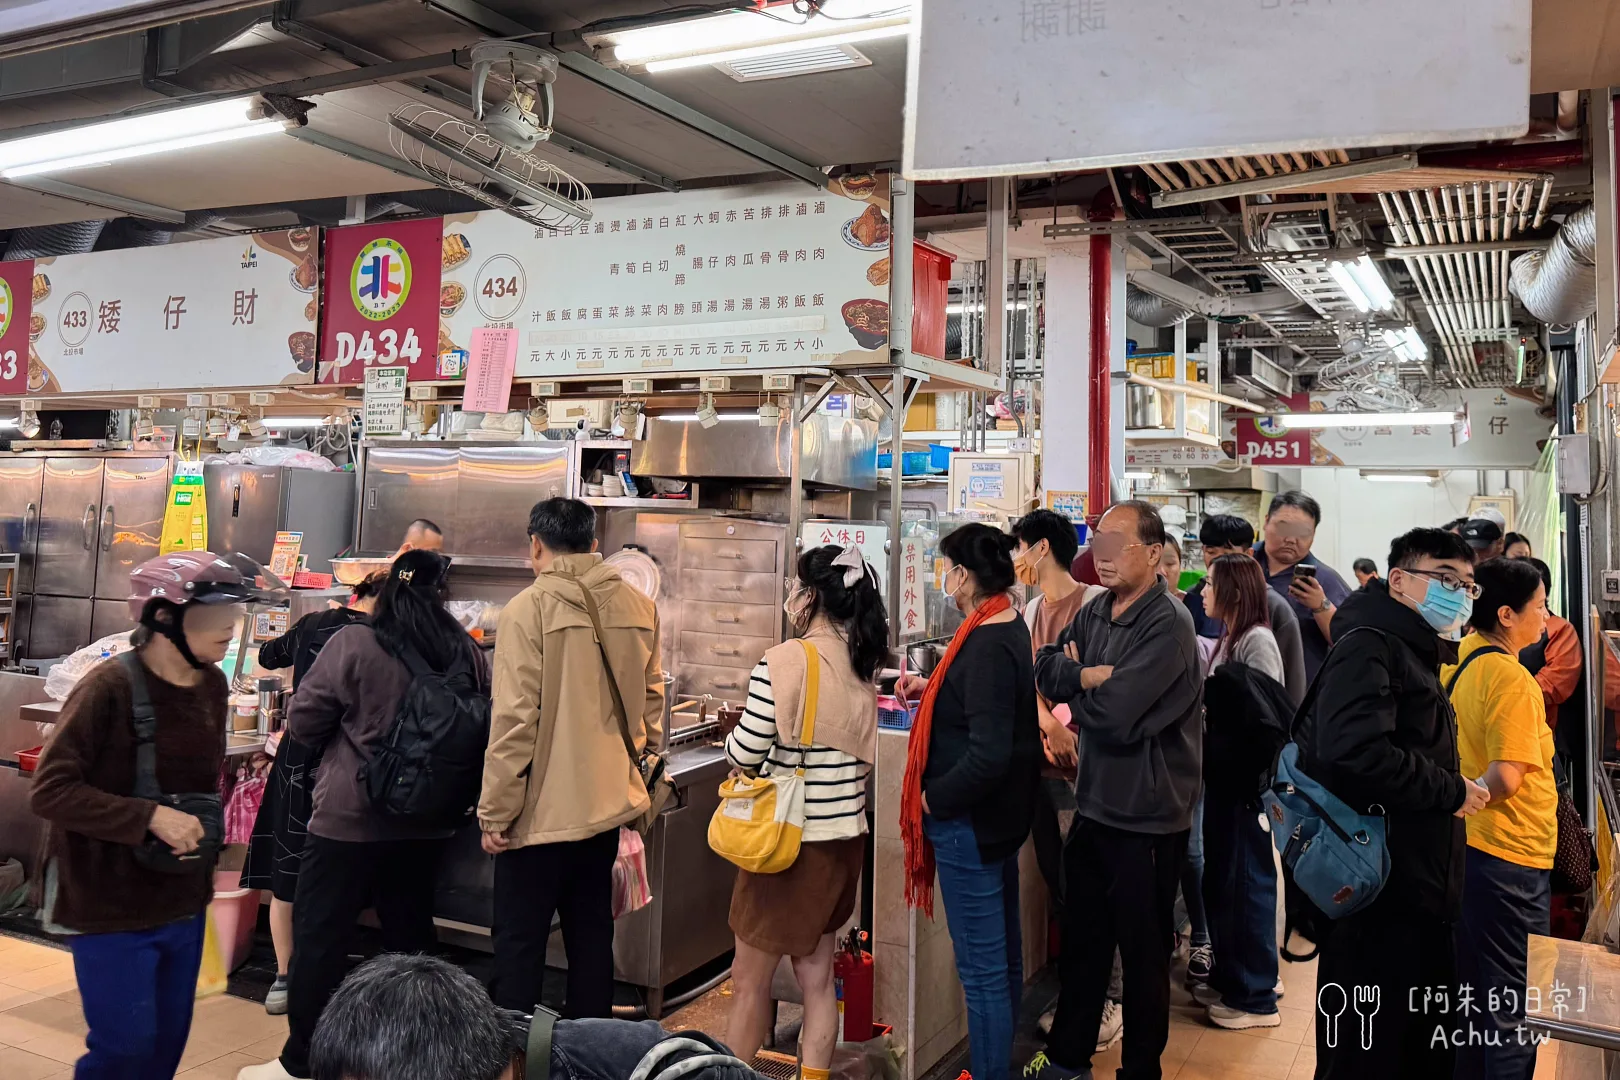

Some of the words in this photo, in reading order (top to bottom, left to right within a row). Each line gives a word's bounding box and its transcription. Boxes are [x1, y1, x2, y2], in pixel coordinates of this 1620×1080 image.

[482, 276, 518, 298] 434
[63, 310, 87, 328] 433
[336, 327, 422, 368] D434
[1246, 441, 1300, 459] D451
[820, 528, 865, 545] 公休日
[903, 543, 918, 629] 禁用外食
